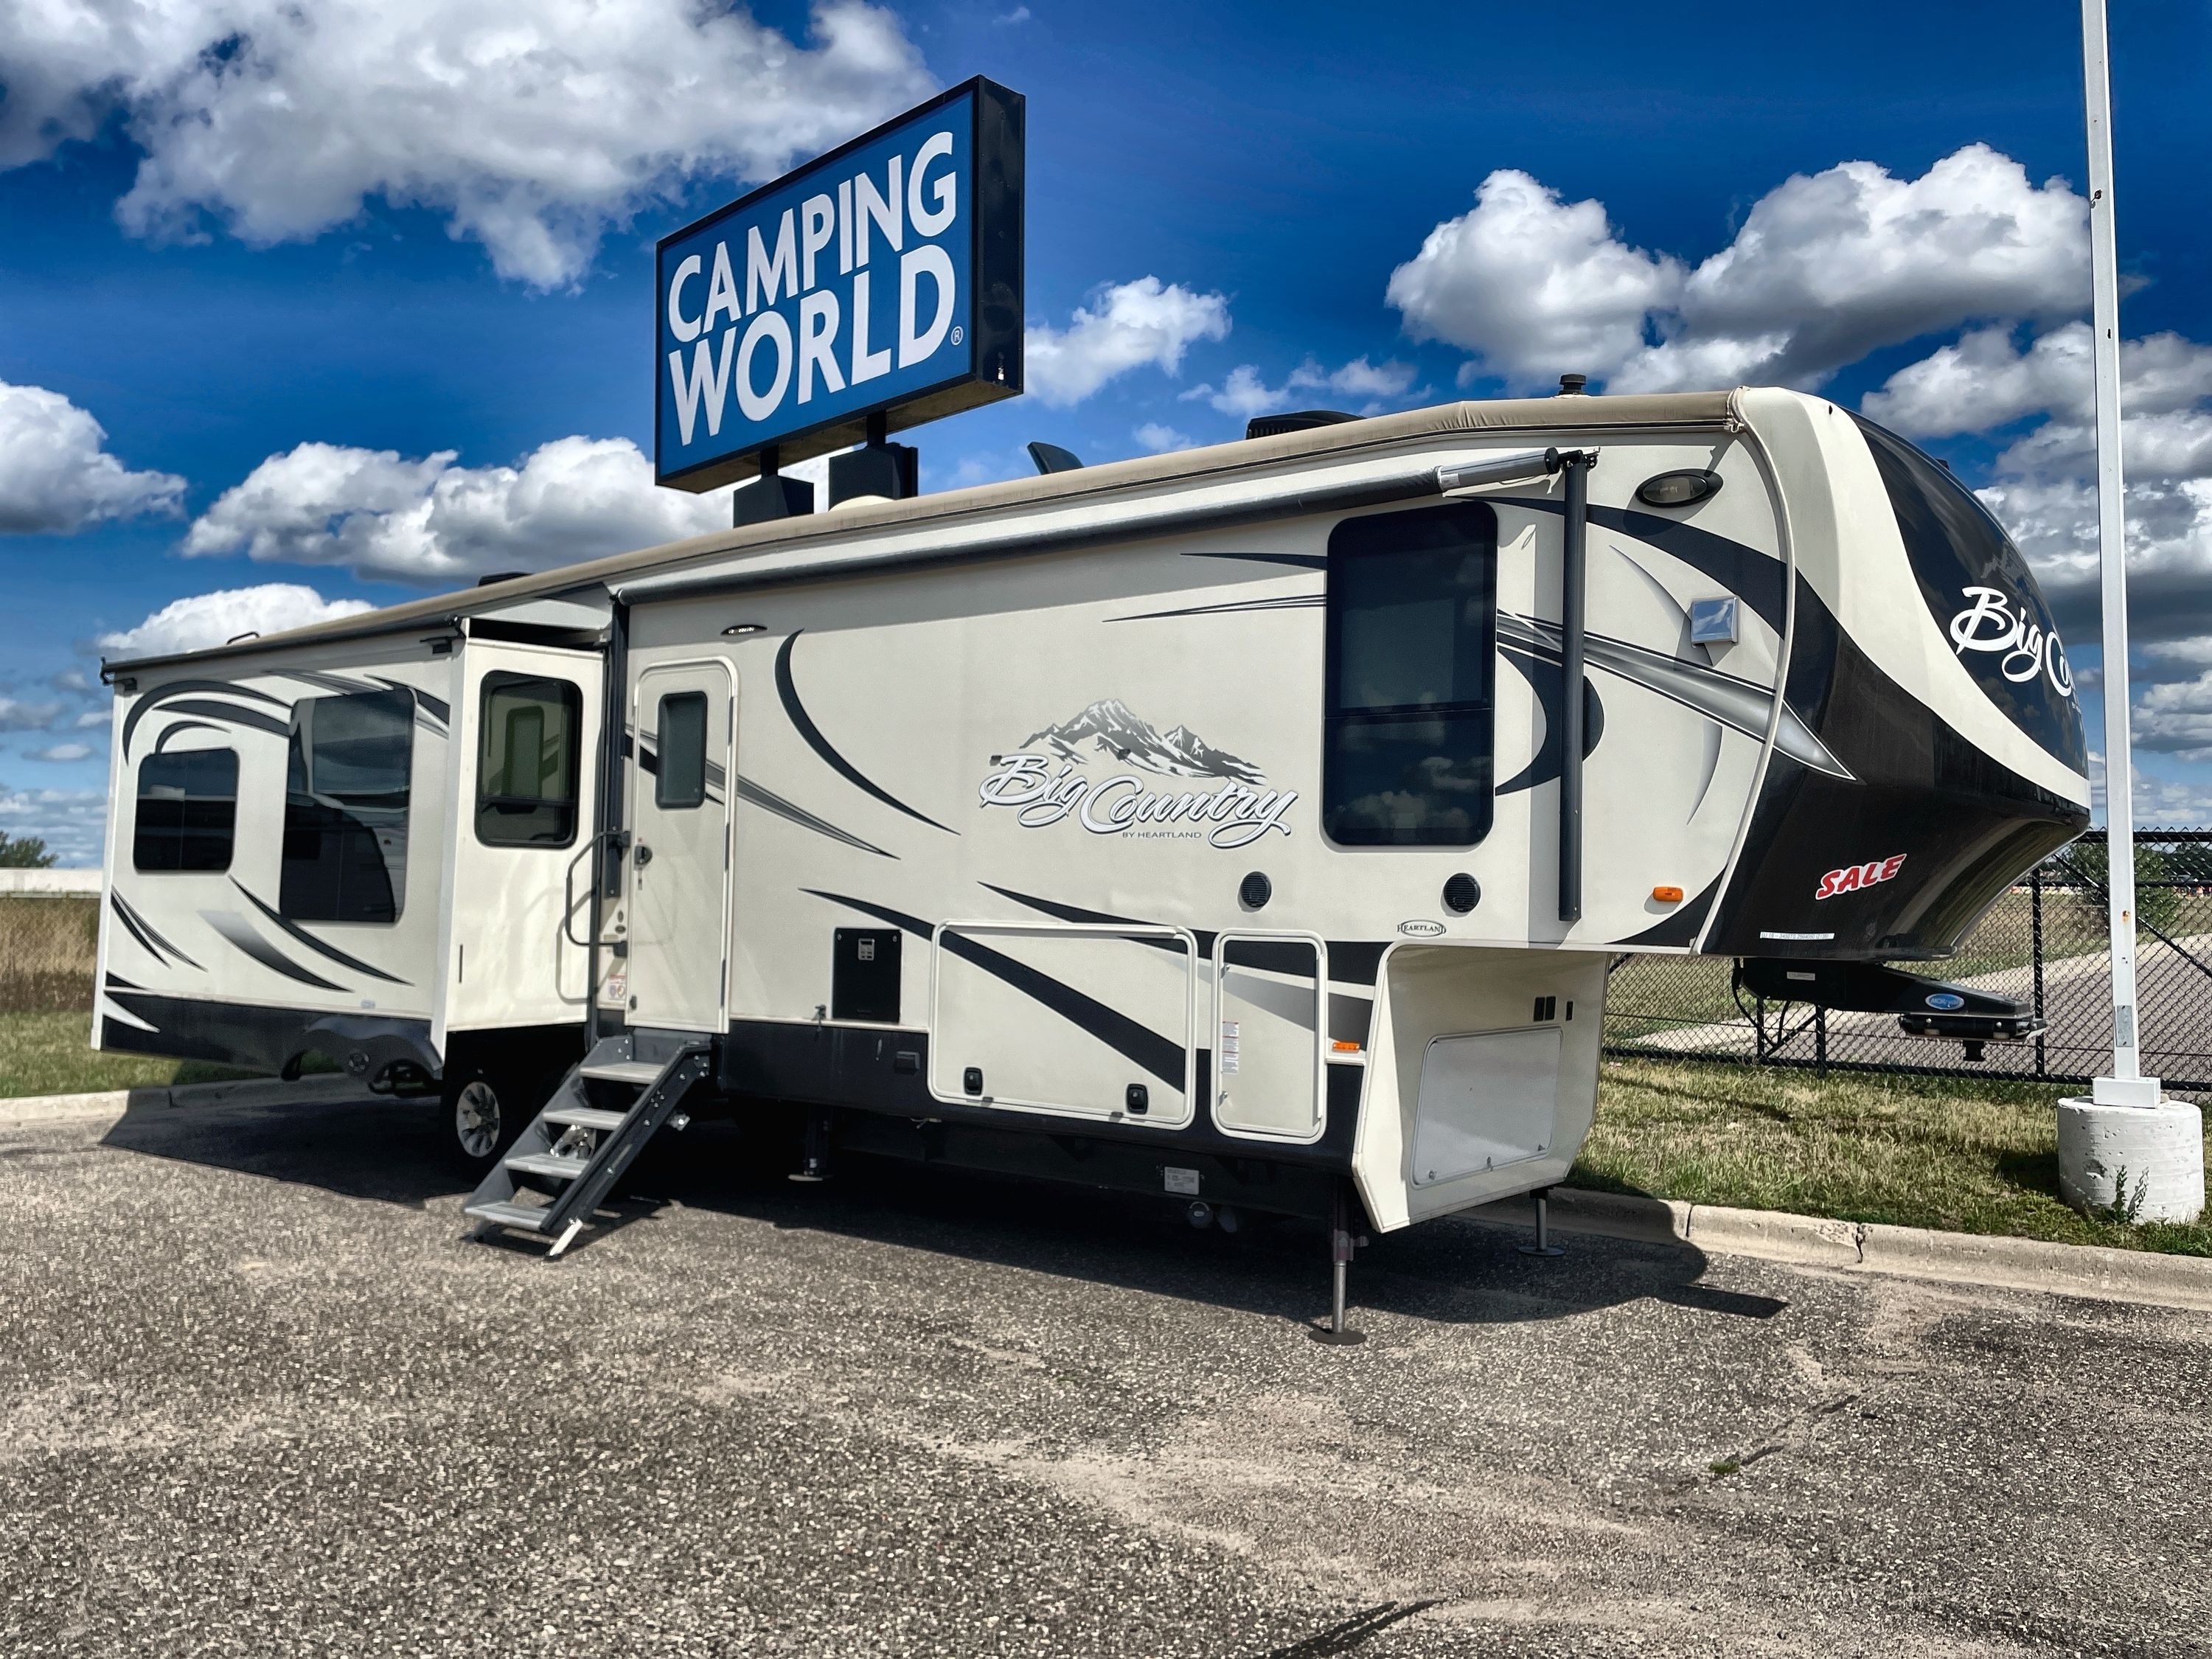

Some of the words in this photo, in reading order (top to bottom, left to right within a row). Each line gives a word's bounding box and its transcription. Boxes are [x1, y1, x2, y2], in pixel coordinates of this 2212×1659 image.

[668, 131, 956, 343] CAMPING
[668, 244, 956, 446] WORLD
[1950, 586, 2043, 682] Big
[979, 754, 1088, 828] Big
[1079, 776, 1298, 849] Country
[1815, 853, 1907, 900] SALE
[1397, 923, 1447, 933] HEARTLAND
